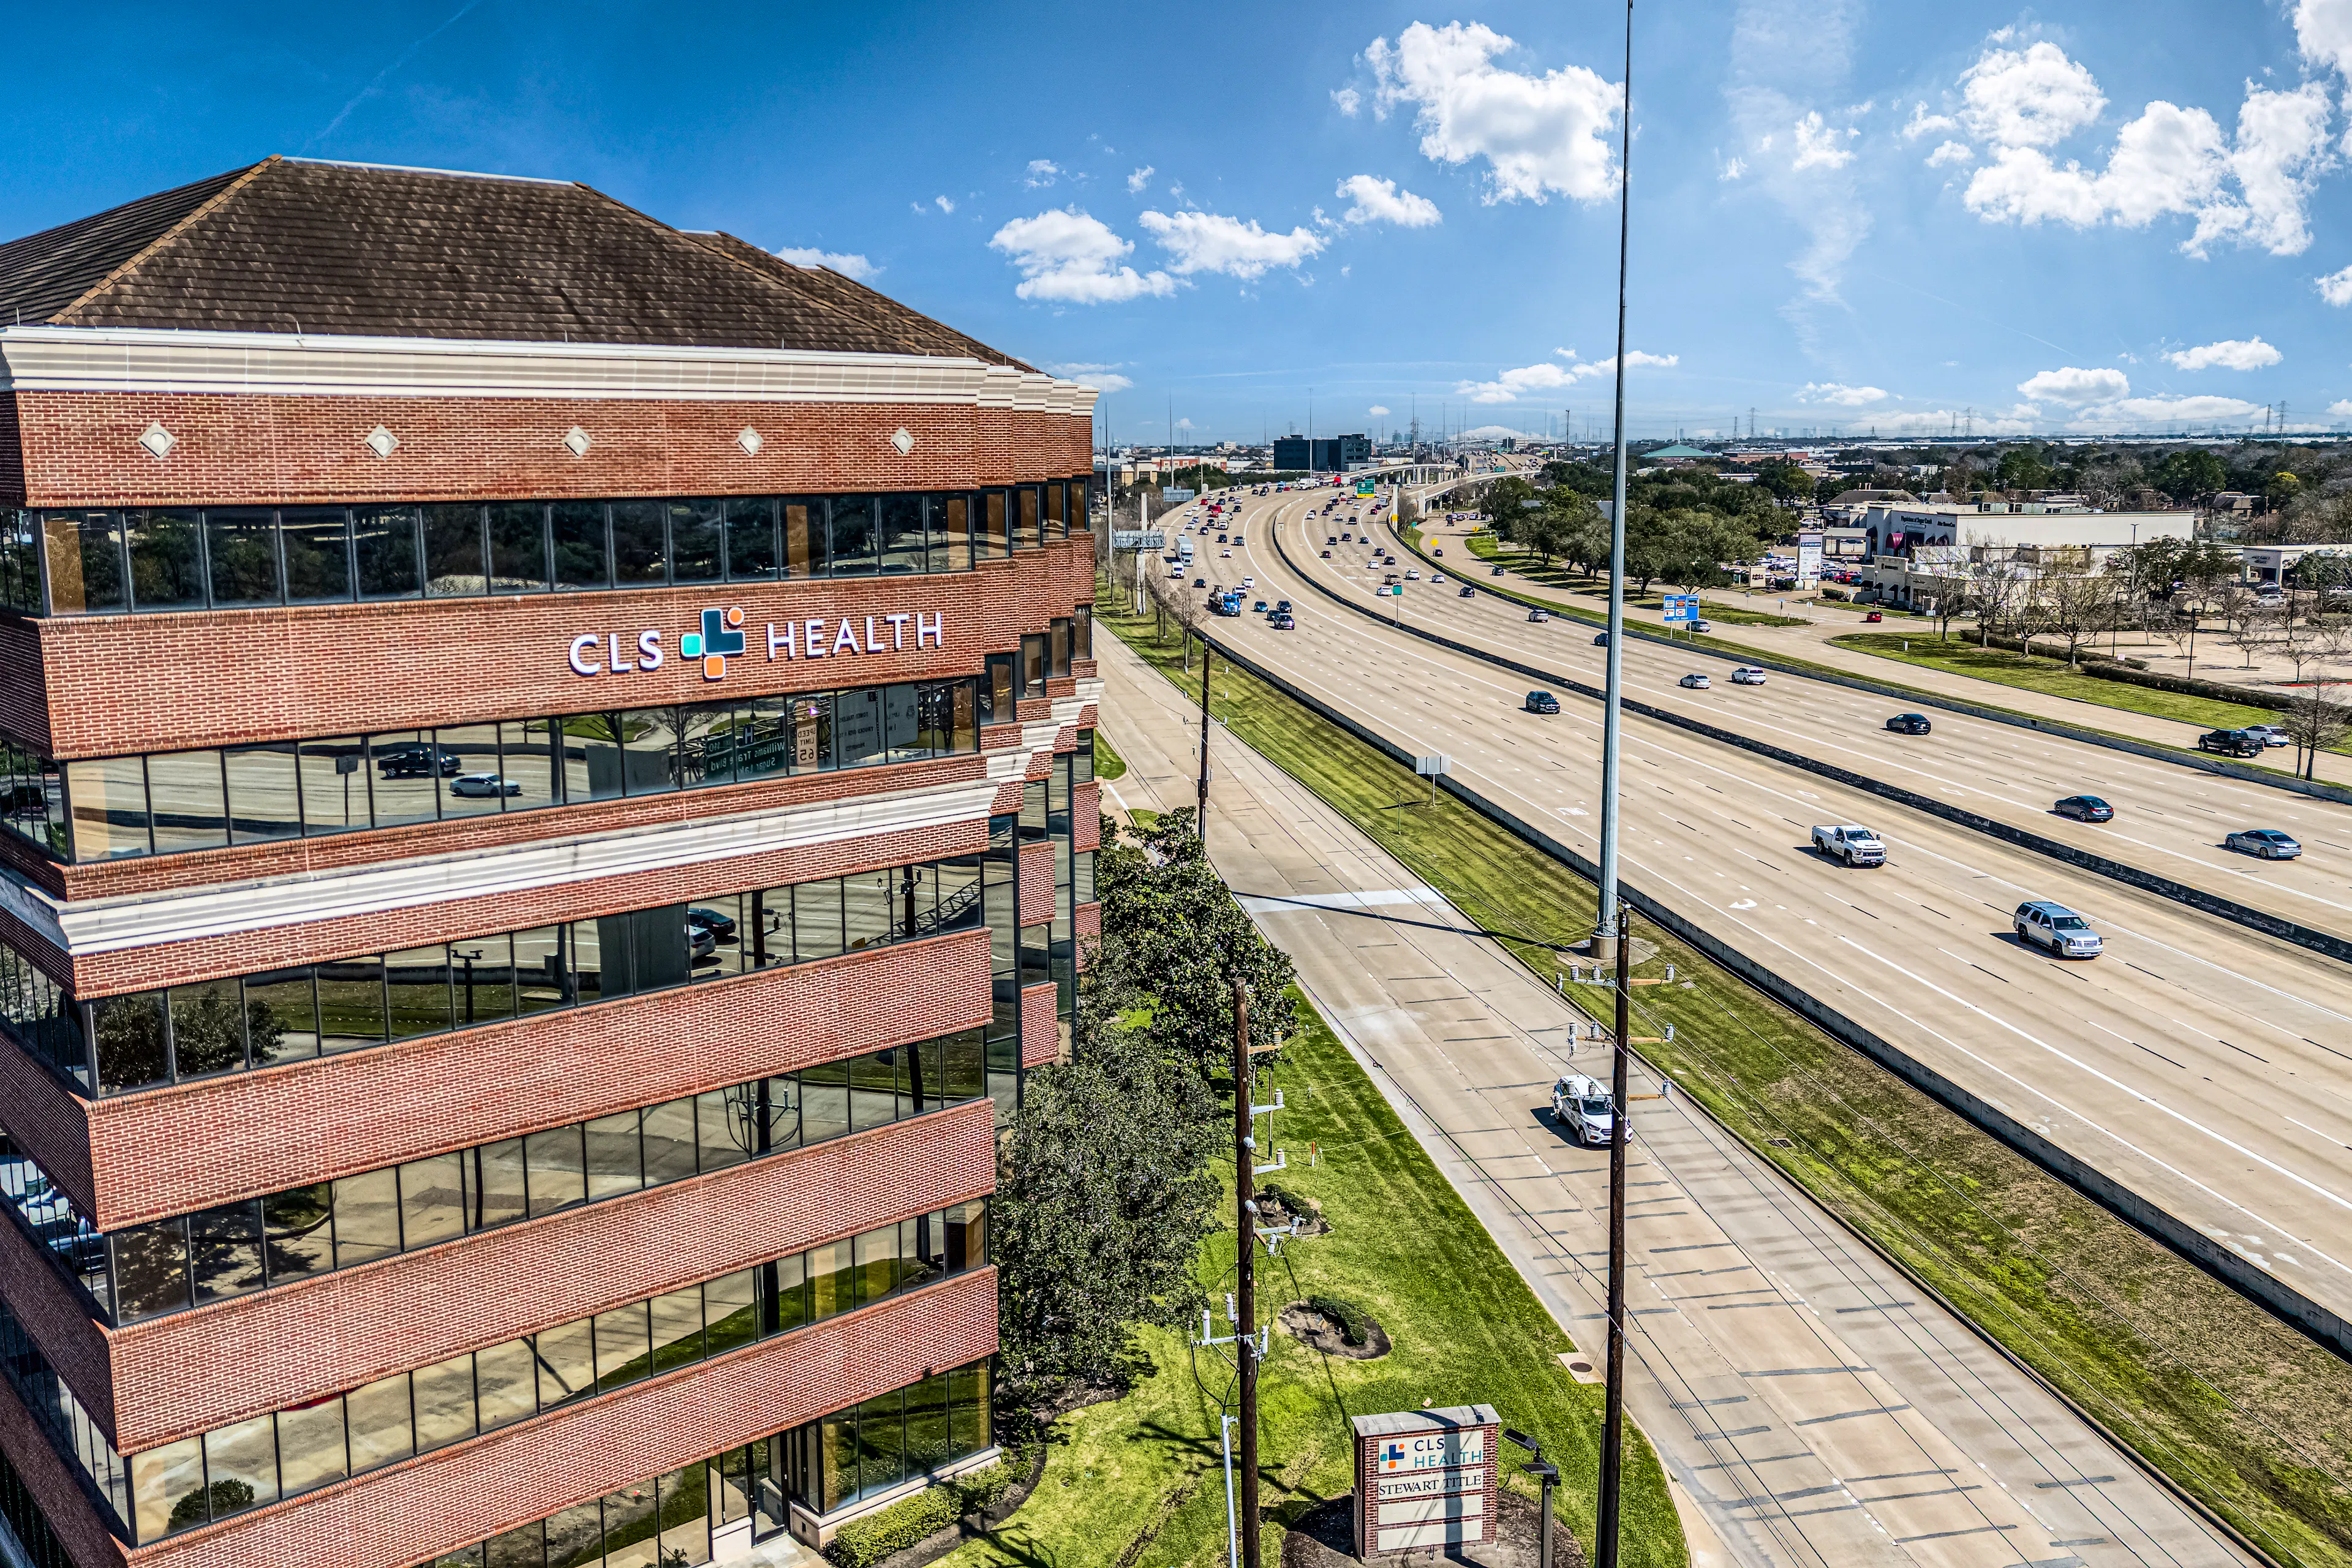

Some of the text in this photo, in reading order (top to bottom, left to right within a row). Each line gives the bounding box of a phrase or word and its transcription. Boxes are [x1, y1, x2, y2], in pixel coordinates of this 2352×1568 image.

[569, 611, 943, 677] CLS HEALTH
[1414, 1438, 1445, 1452] CLS
[1414, 1450, 1482, 1468] HEALTH
[1379, 1475, 1482, 1496] STEWART TITLE
